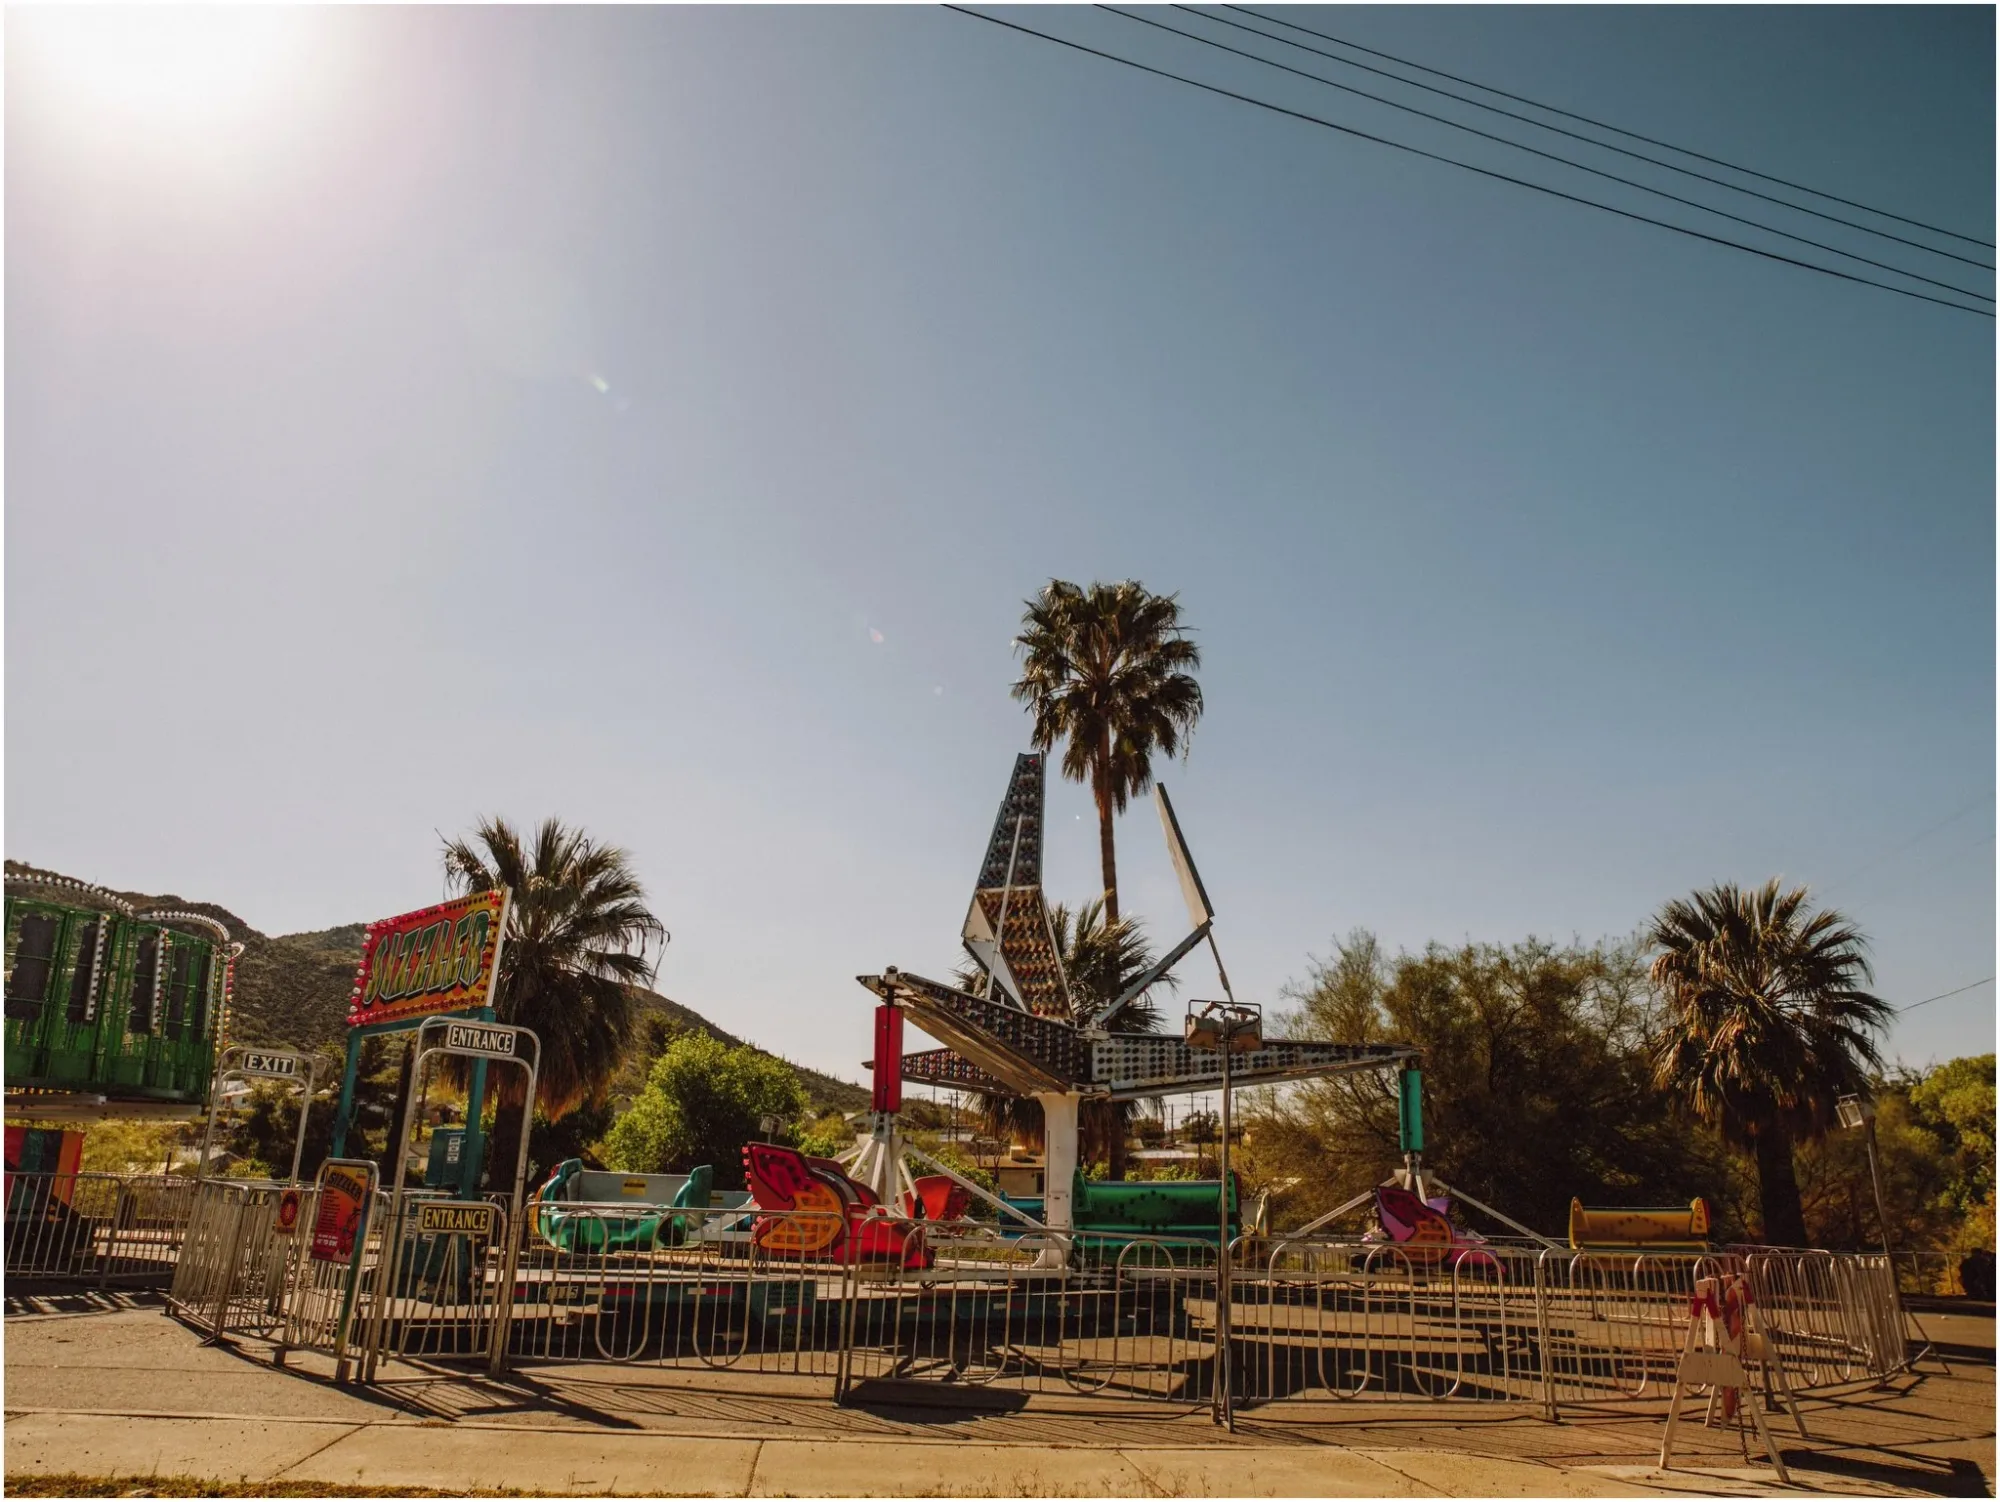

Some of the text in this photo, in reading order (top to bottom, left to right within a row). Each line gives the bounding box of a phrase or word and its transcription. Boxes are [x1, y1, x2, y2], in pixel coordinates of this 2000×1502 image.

[362, 909, 491, 1008] SIZZLER
[451, 1026, 512, 1052] ENTRANCE
[247, 1054, 292, 1073] EXIT
[328, 1171, 363, 1202] SIZZLER
[423, 1208, 488, 1230] ENTRANCE
